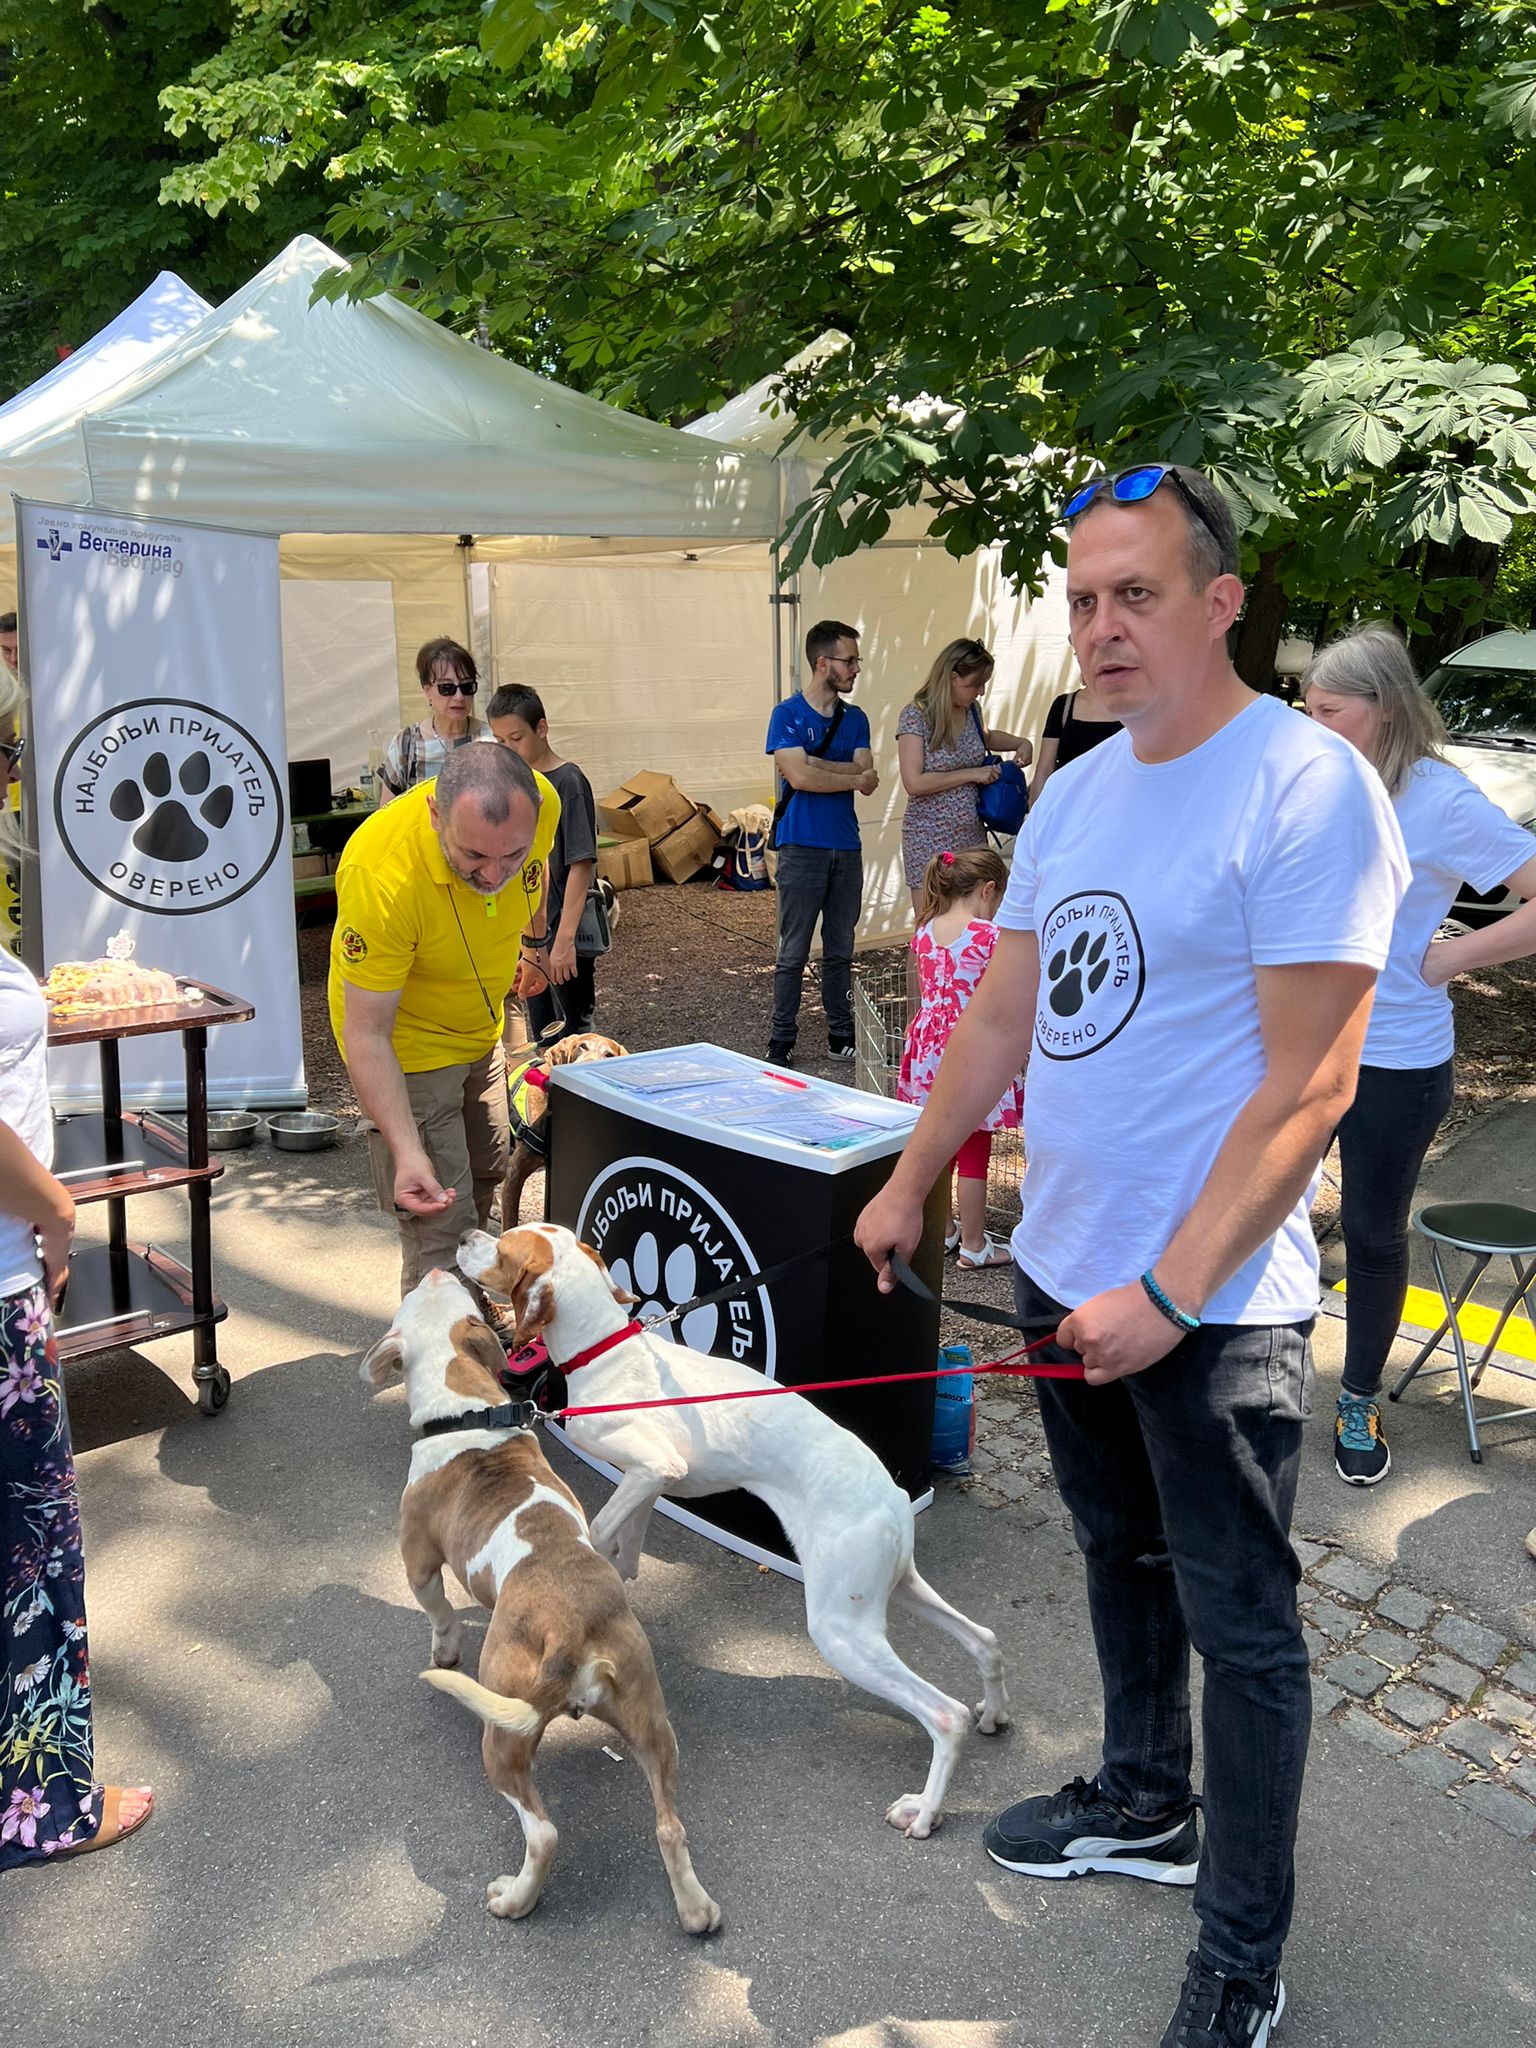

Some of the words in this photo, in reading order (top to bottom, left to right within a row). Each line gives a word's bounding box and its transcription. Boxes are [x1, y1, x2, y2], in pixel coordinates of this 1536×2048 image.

[75, 716, 160, 814] НАЈБОЉИ
[169, 716, 266, 817] ПРИЈАТЕЉ
[109, 861, 240, 898] ОВЕРЕНО
[1098, 905, 1130, 988] ПРИЈАТЕЉ
[591, 1182, 653, 1250] ЈБОЉИ
[659, 1187, 754, 1359] ПРИЈАЕЉ
